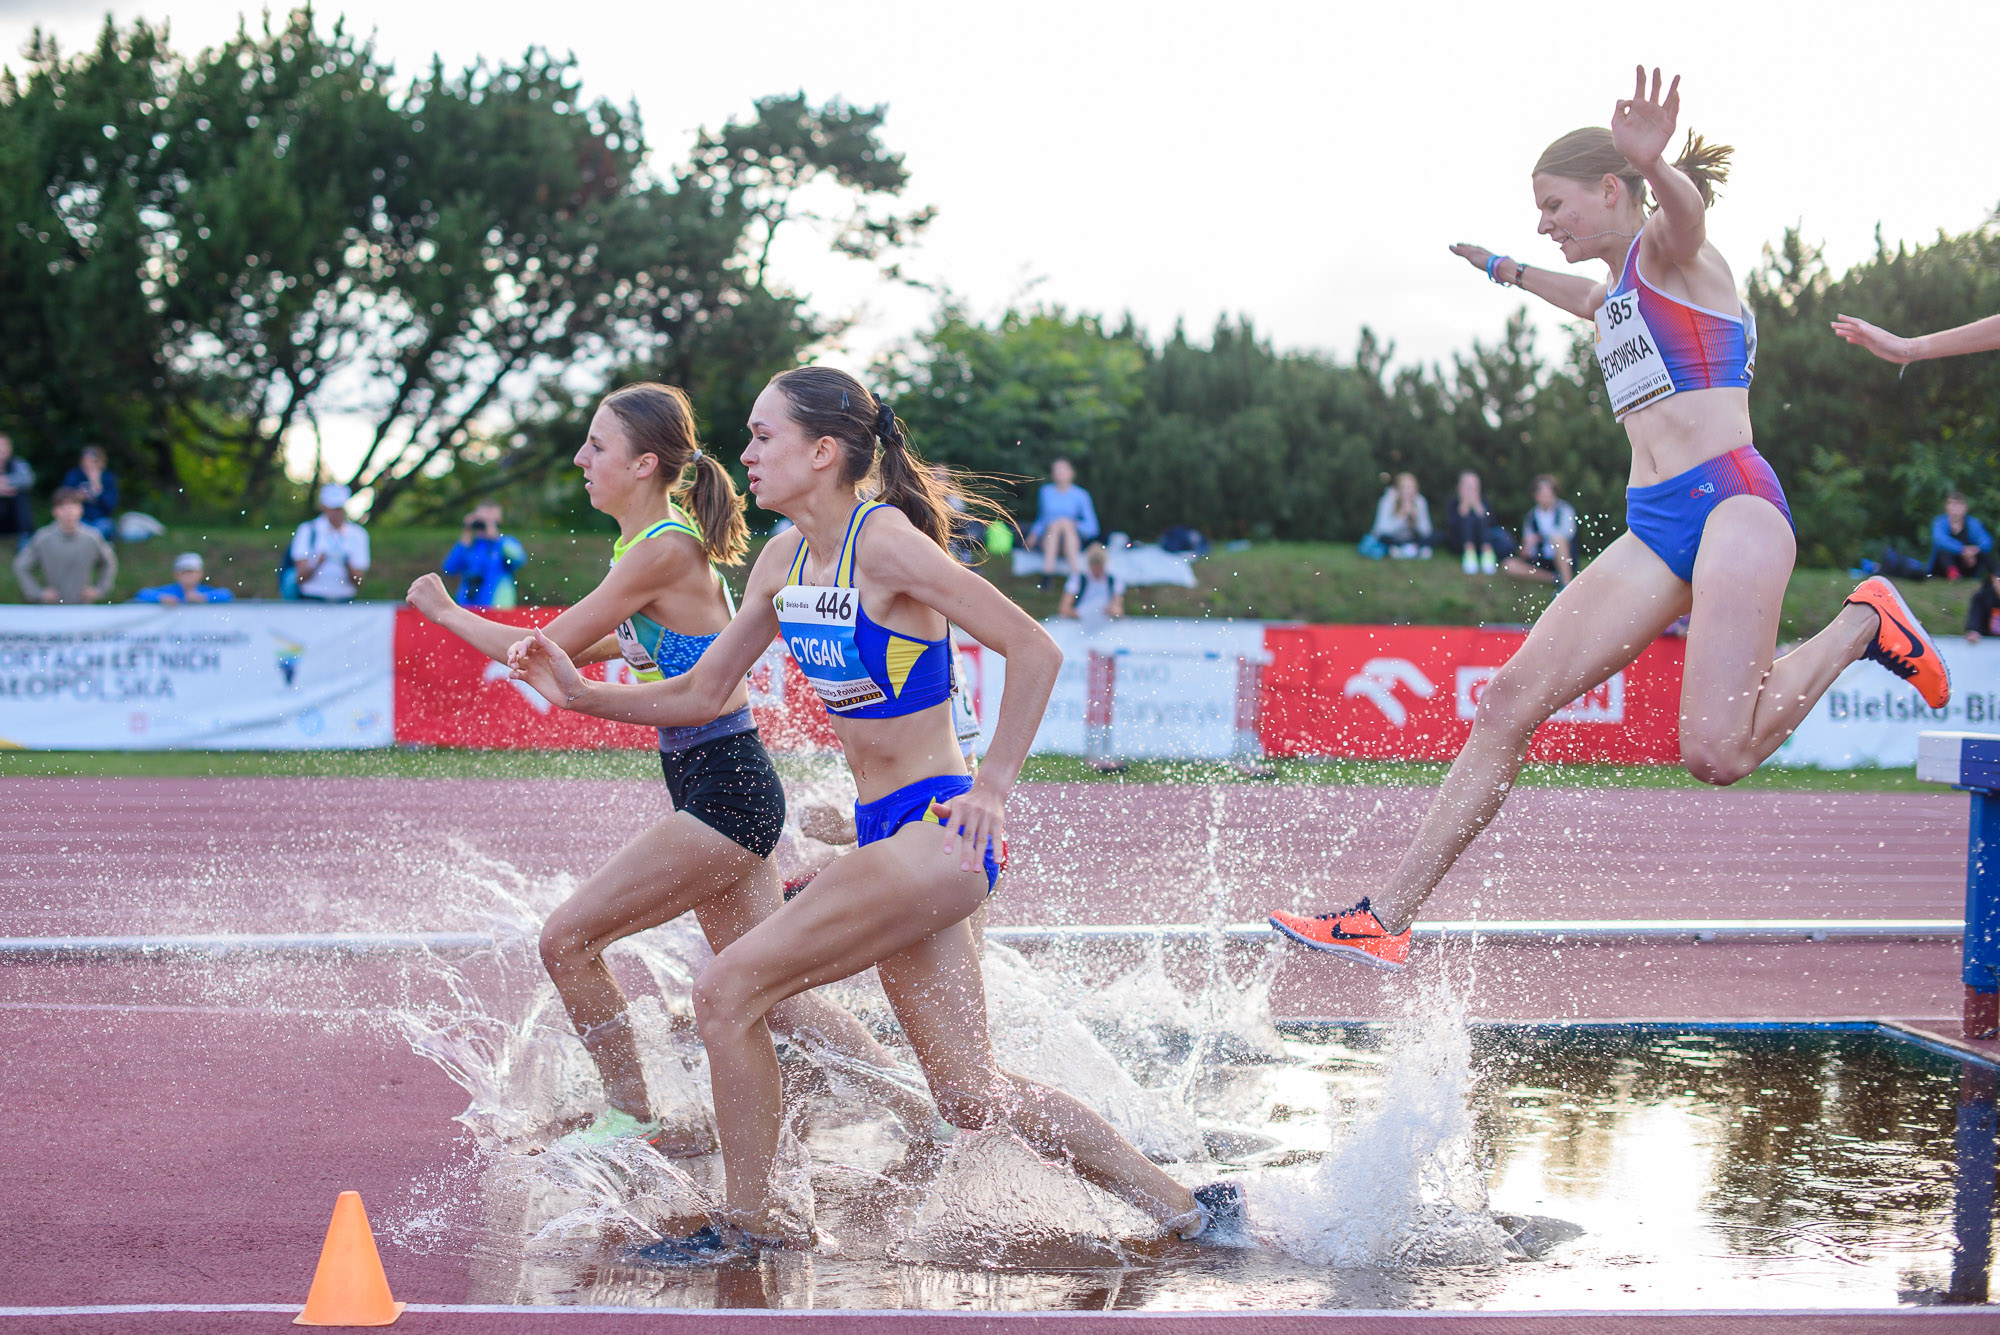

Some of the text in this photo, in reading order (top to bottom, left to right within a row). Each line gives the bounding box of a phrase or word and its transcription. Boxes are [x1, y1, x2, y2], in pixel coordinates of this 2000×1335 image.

[1653, 373, 1668, 385] U18
[815, 591, 852, 620] 446
[790, 636, 847, 668] CYGAN
[837, 686, 861, 697] Polski
[861, 683, 877, 691] U18
